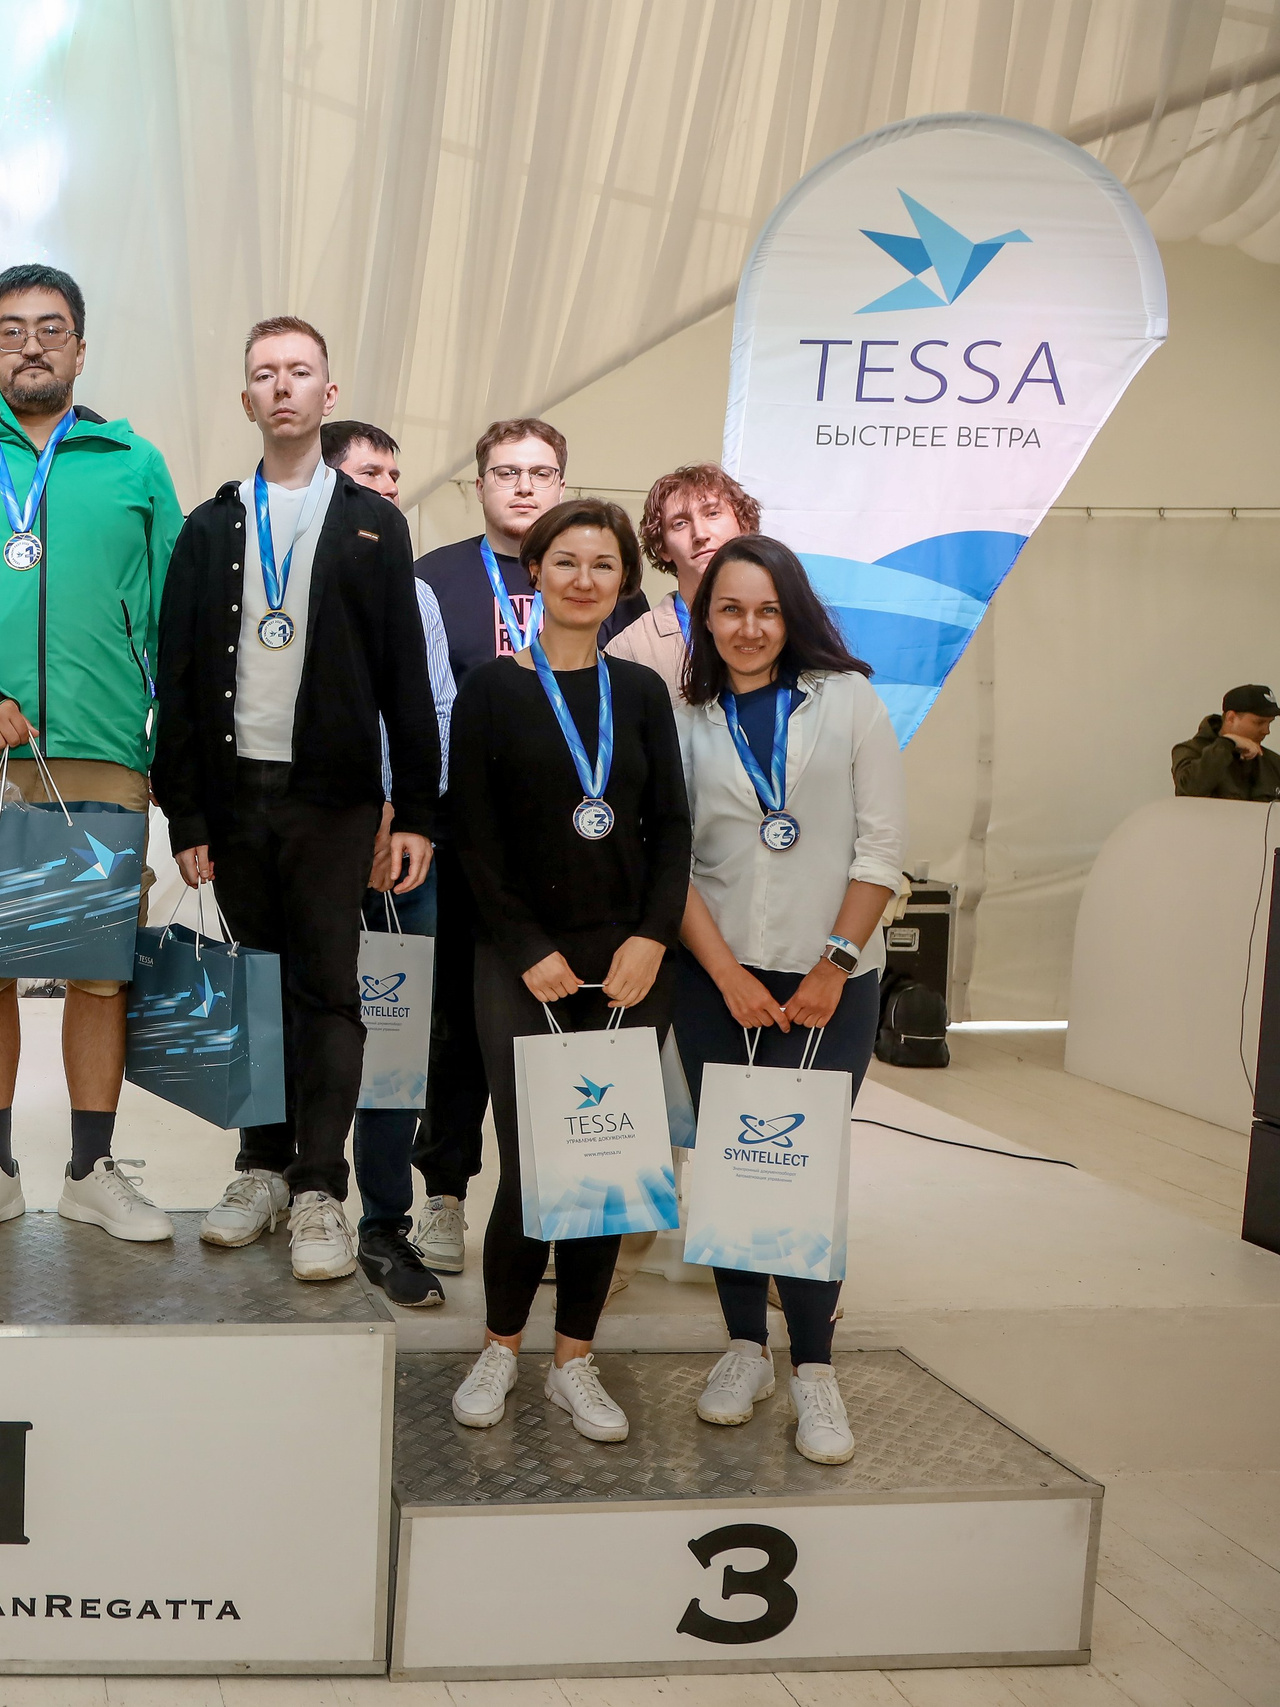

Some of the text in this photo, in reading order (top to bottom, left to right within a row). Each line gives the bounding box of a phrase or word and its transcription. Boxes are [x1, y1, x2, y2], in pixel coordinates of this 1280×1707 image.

[799, 339, 1066, 406] TESSA
[815, 424, 1042, 449] БЫСТРЕЕ ВЕТРА
[139, 954, 154, 965] TESSA
[361, 1005, 411, 1018] NTELLECT
[563, 1112, 635, 1136] TESSA
[723, 1147, 810, 1168] SYNTELLECT
[676, 1523, 799, 1645] 3
